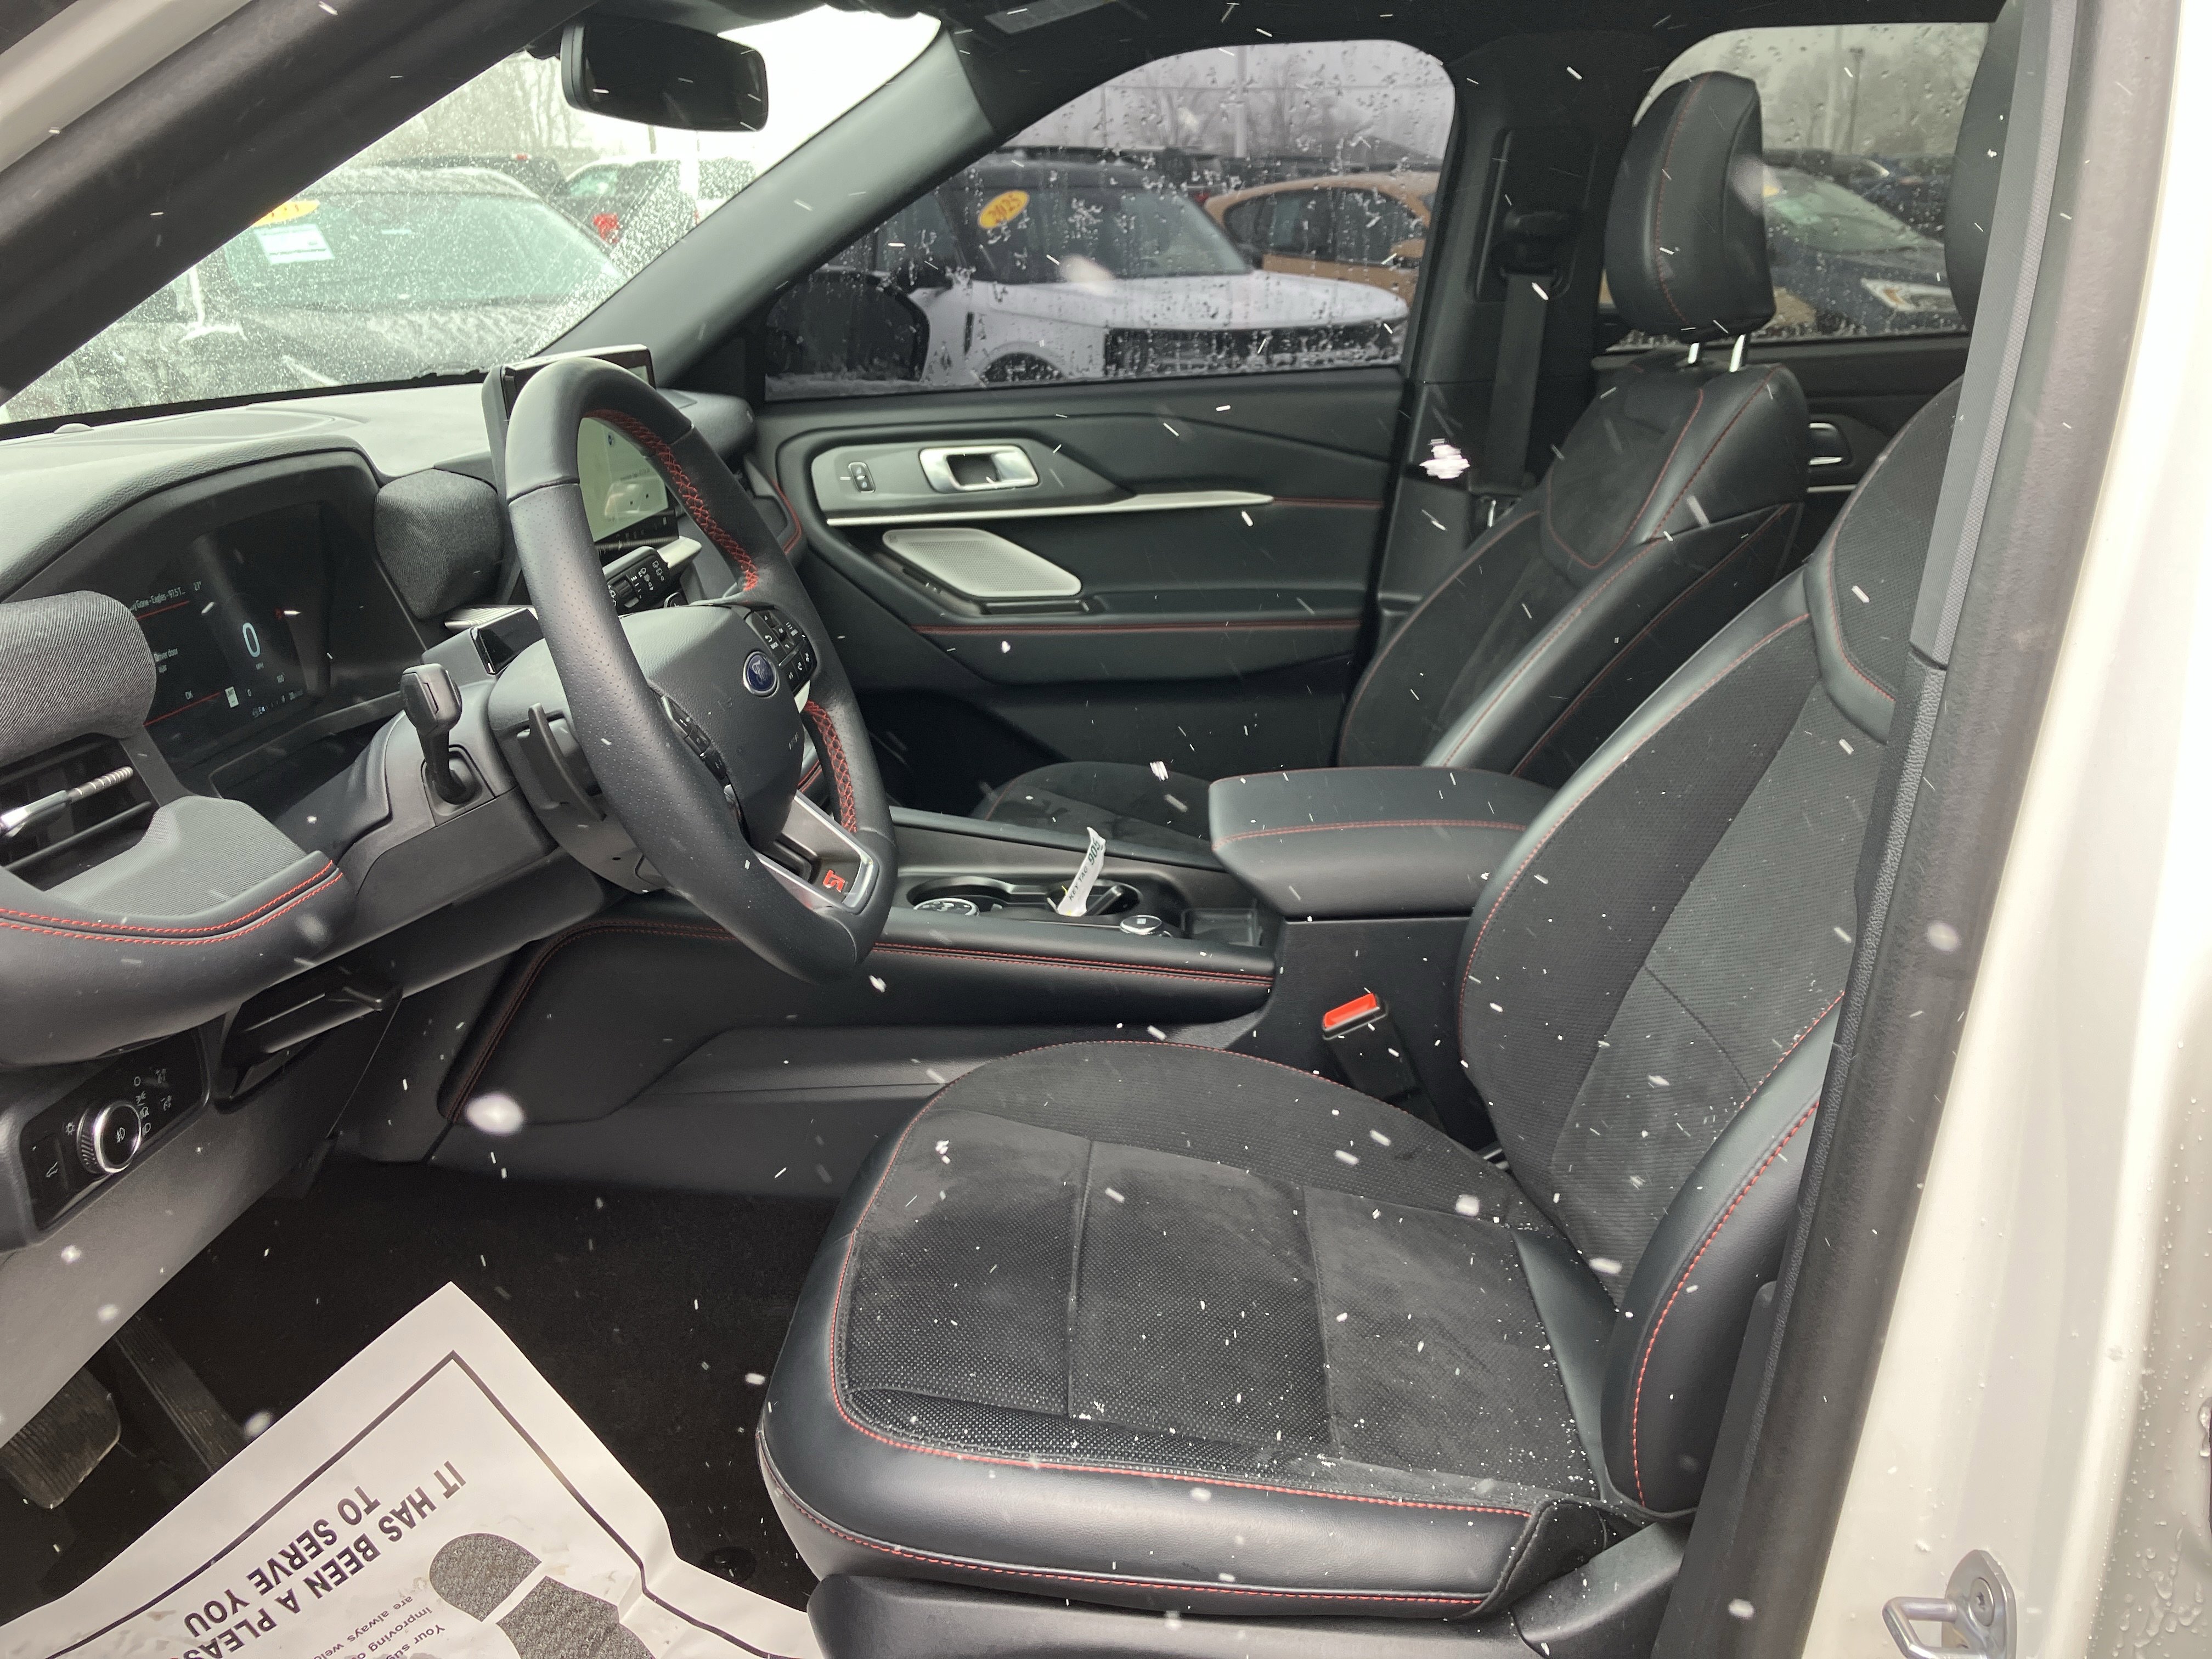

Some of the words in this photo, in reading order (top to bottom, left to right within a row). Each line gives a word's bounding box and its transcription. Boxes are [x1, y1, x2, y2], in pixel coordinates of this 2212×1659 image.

[242, 622, 261, 657] 0
[185, 690, 194, 700] OK
[823, 869, 845, 893] ST
[1068, 883, 1079, 901] KEY
[1077, 866, 1088, 883] TAG
[433, 1460, 466, 1499] IT
[337, 1486, 381, 1525] TO
[379, 1486, 437, 1542] HAS
[246, 1519, 338, 1596] SERVE
[303, 1533, 381, 1599] BEEN
[184, 1589, 250, 1638] YOU
[274, 1588, 301, 1614] A
[393, 1596, 413, 1610] are
[347, 1611, 390, 1642] always
[368, 1607, 433, 1652] improving
[414, 1624, 445, 1644] Your
